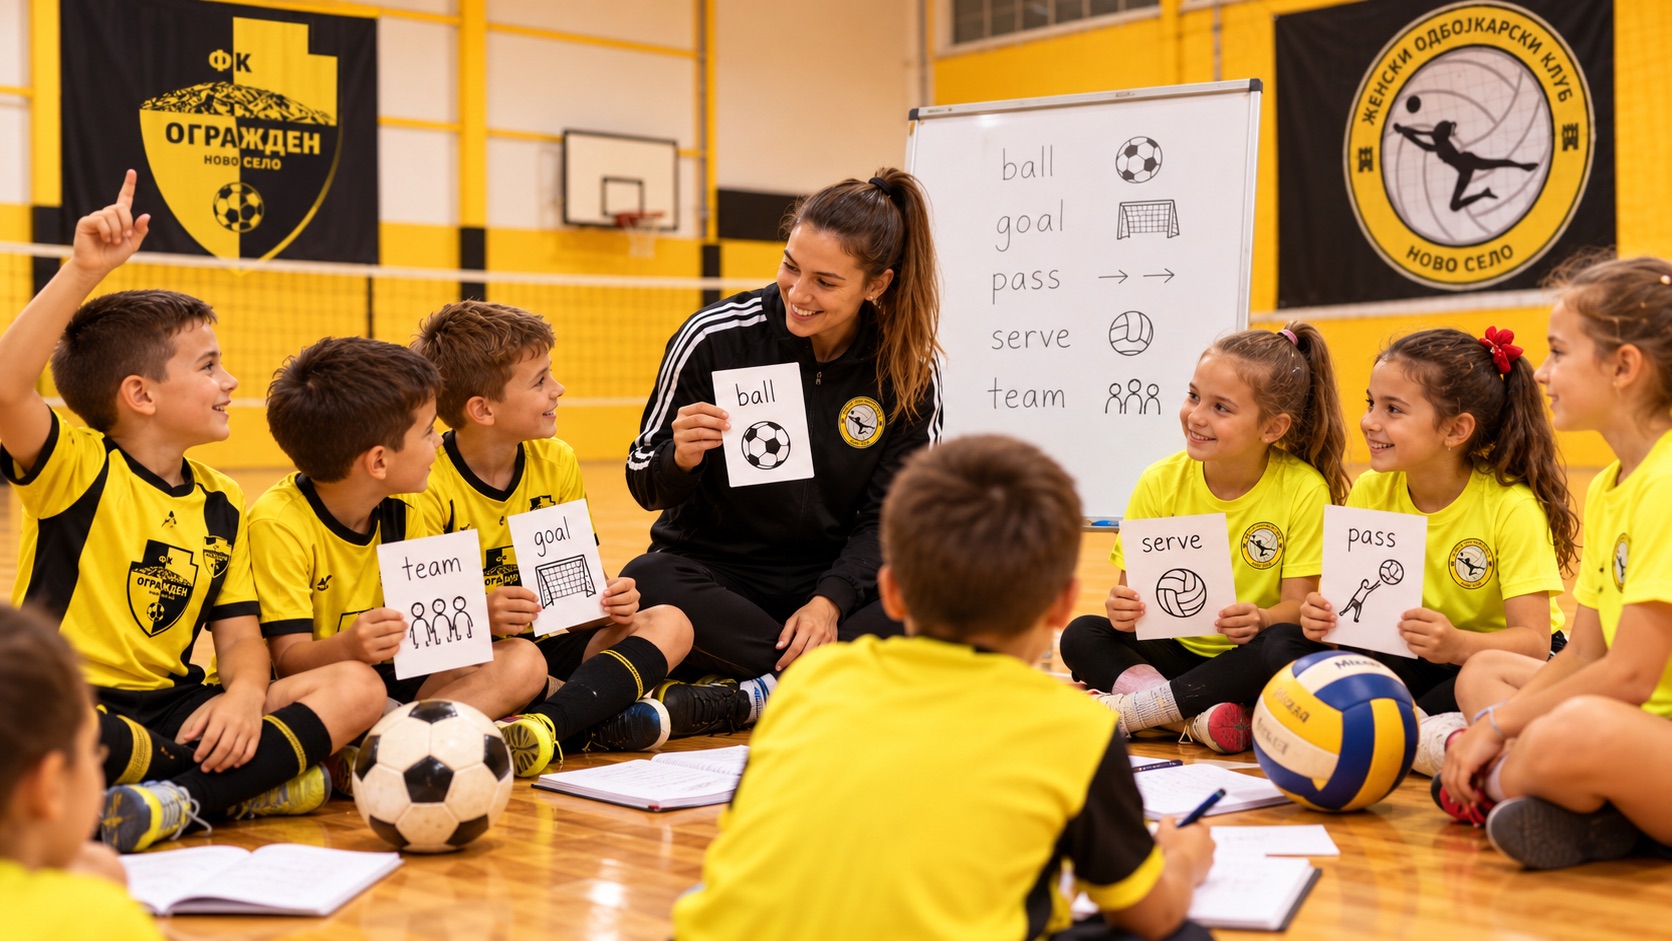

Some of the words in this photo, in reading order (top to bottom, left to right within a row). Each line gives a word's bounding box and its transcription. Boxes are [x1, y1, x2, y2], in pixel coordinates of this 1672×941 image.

[208, 49, 253, 73] ФК
[1361, 48, 1413, 126] ЖЕНСКИ
[1414, 17, 1543, 55] ОДБОЈКАРСКИ
[1540, 52, 1574, 103] КЛУБ
[165, 122, 321, 156] ОГРАЖДЕН
[203, 155, 239, 167] НОВО
[243, 156, 282, 171] СЕЛО
[1003, 144, 1053, 181] ball
[995, 199, 1064, 253] goal
[1405, 245, 1458, 273] НОВО
[1464, 244, 1514, 272] СЕЛО
[992, 269, 1060, 305] pass
[991, 328, 1071, 350] serve
[735, 379, 776, 407] ball
[987, 377, 1065, 410] team
[534, 516, 571, 557] goal
[1142, 534, 1203, 553] serve
[1347, 527, 1396, 552] pass
[401, 556, 462, 582] team
